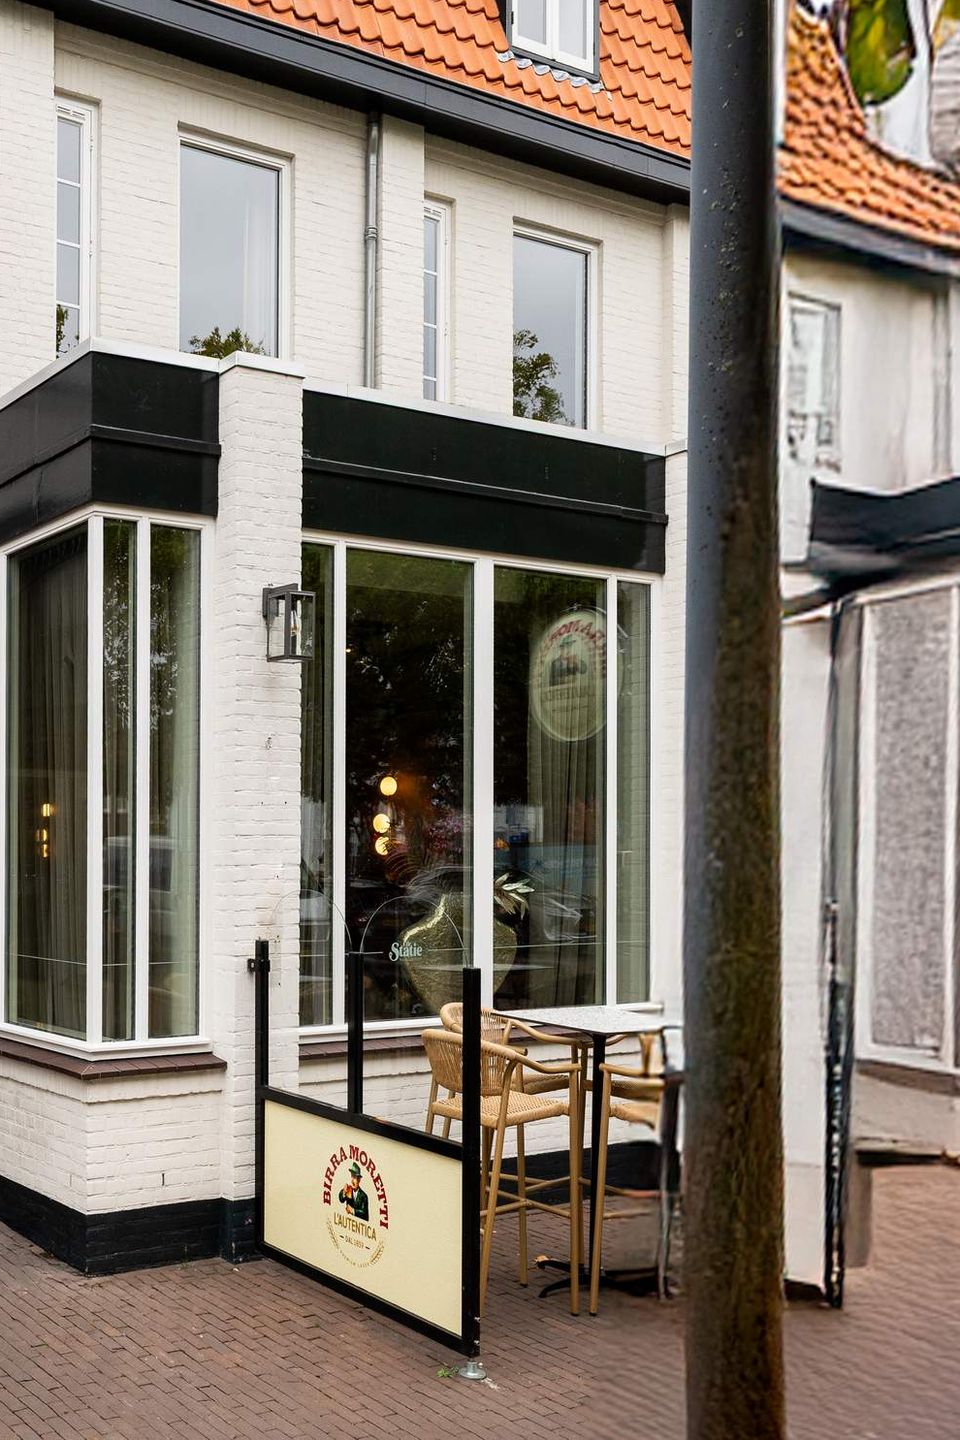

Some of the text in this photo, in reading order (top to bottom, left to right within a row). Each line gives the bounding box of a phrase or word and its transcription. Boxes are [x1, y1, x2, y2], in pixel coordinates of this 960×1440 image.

[388, 942, 423, 962] Statie
[323, 1144, 389, 1230] BIRRA MORETTI
[333, 1212, 377, 1242] L'AUTENTICA
